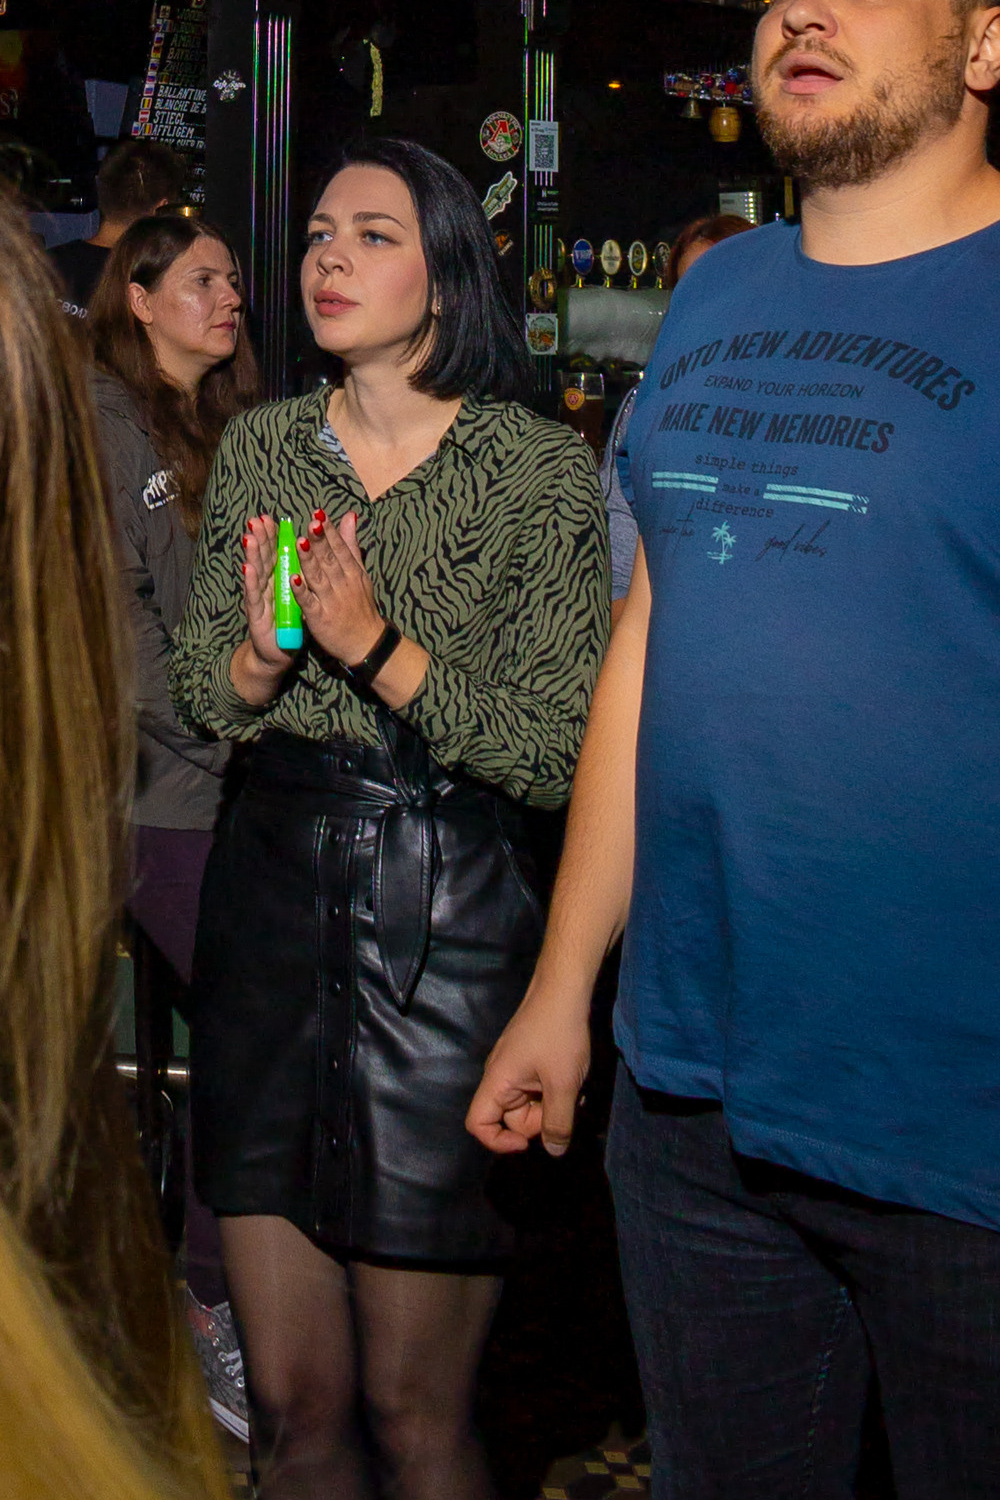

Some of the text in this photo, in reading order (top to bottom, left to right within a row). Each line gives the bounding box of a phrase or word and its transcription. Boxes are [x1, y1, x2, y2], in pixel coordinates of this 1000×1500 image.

[154, 98, 189, 112] BLANCHE
[189, 102, 200, 113] DE
[151, 123, 195, 139] AFFLIGEM
[659, 330, 976, 411] ONTO NEW ADVENTURES
[703, 374, 866, 399] EXPAND YOUR HORIZON
[658, 402, 895, 454] MAKE NEW MEMORIES
[695, 453, 799, 479] simple things
[722, 483, 751, 494] make
[696, 498, 774, 519] difference
